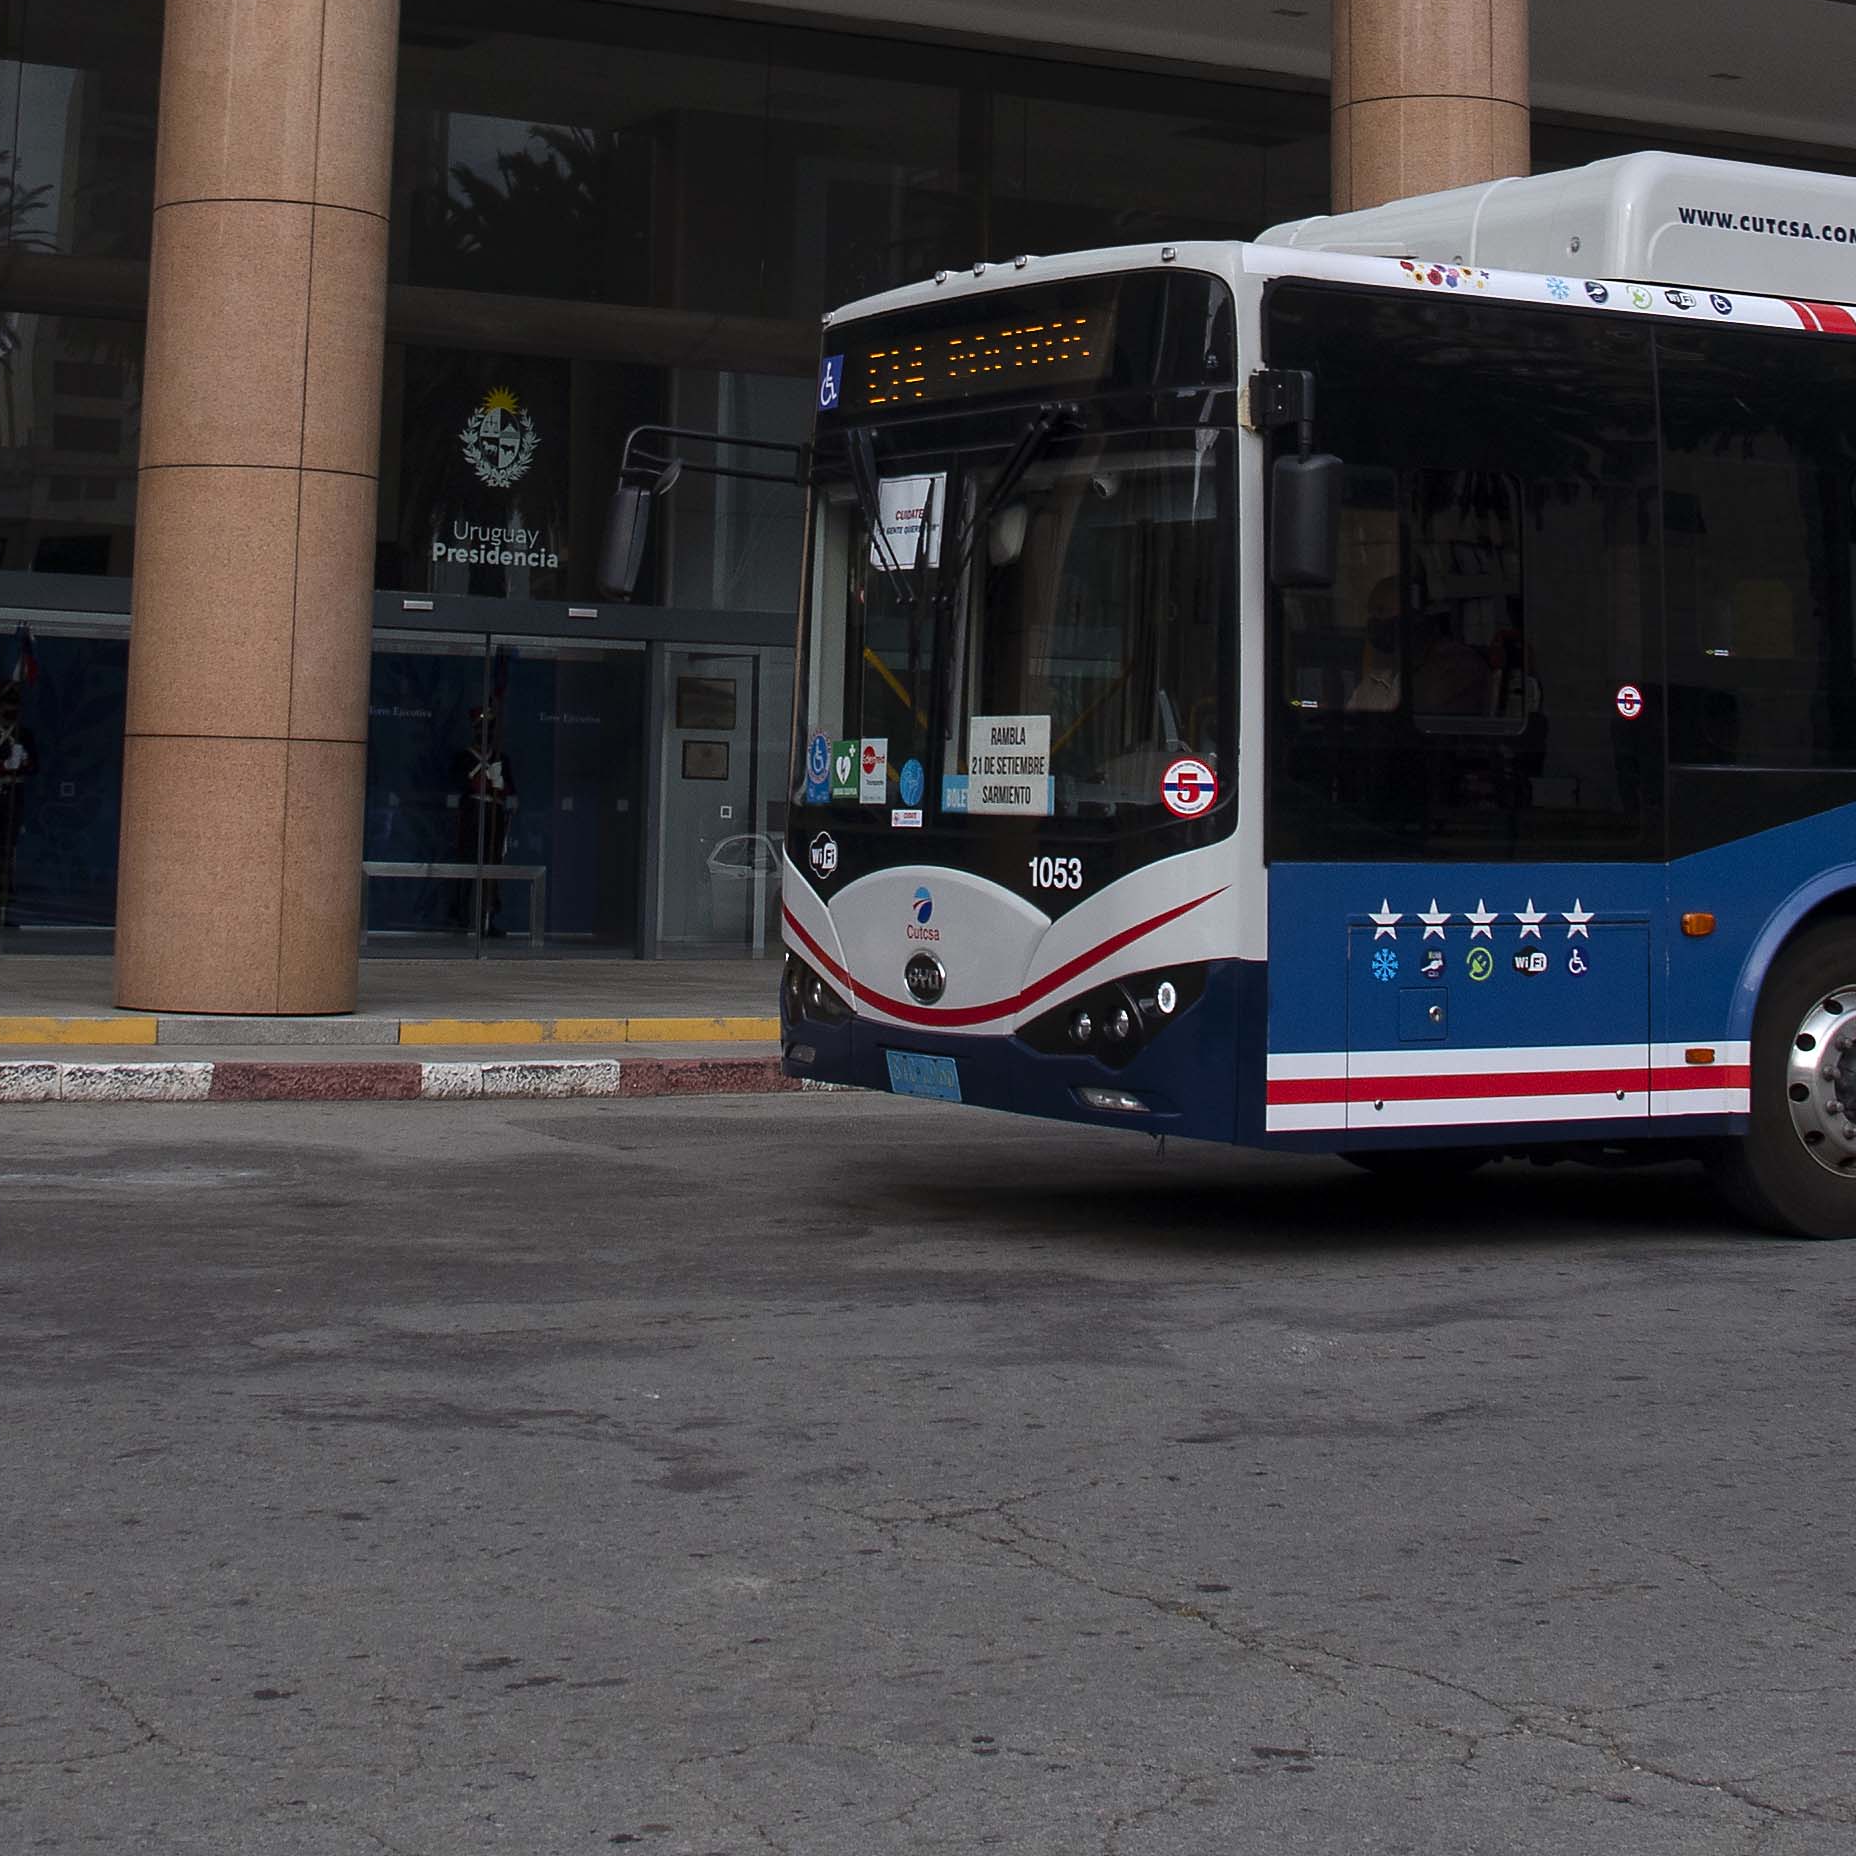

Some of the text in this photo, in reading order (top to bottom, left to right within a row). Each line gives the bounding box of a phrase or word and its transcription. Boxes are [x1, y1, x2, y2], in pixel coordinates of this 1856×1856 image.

[453, 520, 540, 549] Uruguay
[431, 542, 559, 569] Presidencia
[991, 726, 1026, 746] RAMBLA
[971, 756, 1045, 775] 21 DE SETIEMBRE
[982, 785, 1031, 805] SARMIENTO
[1177, 773, 1200, 803] 5
[1028, 856, 1083, 890] 1053
[906, 925, 940, 941] Cutcsa
